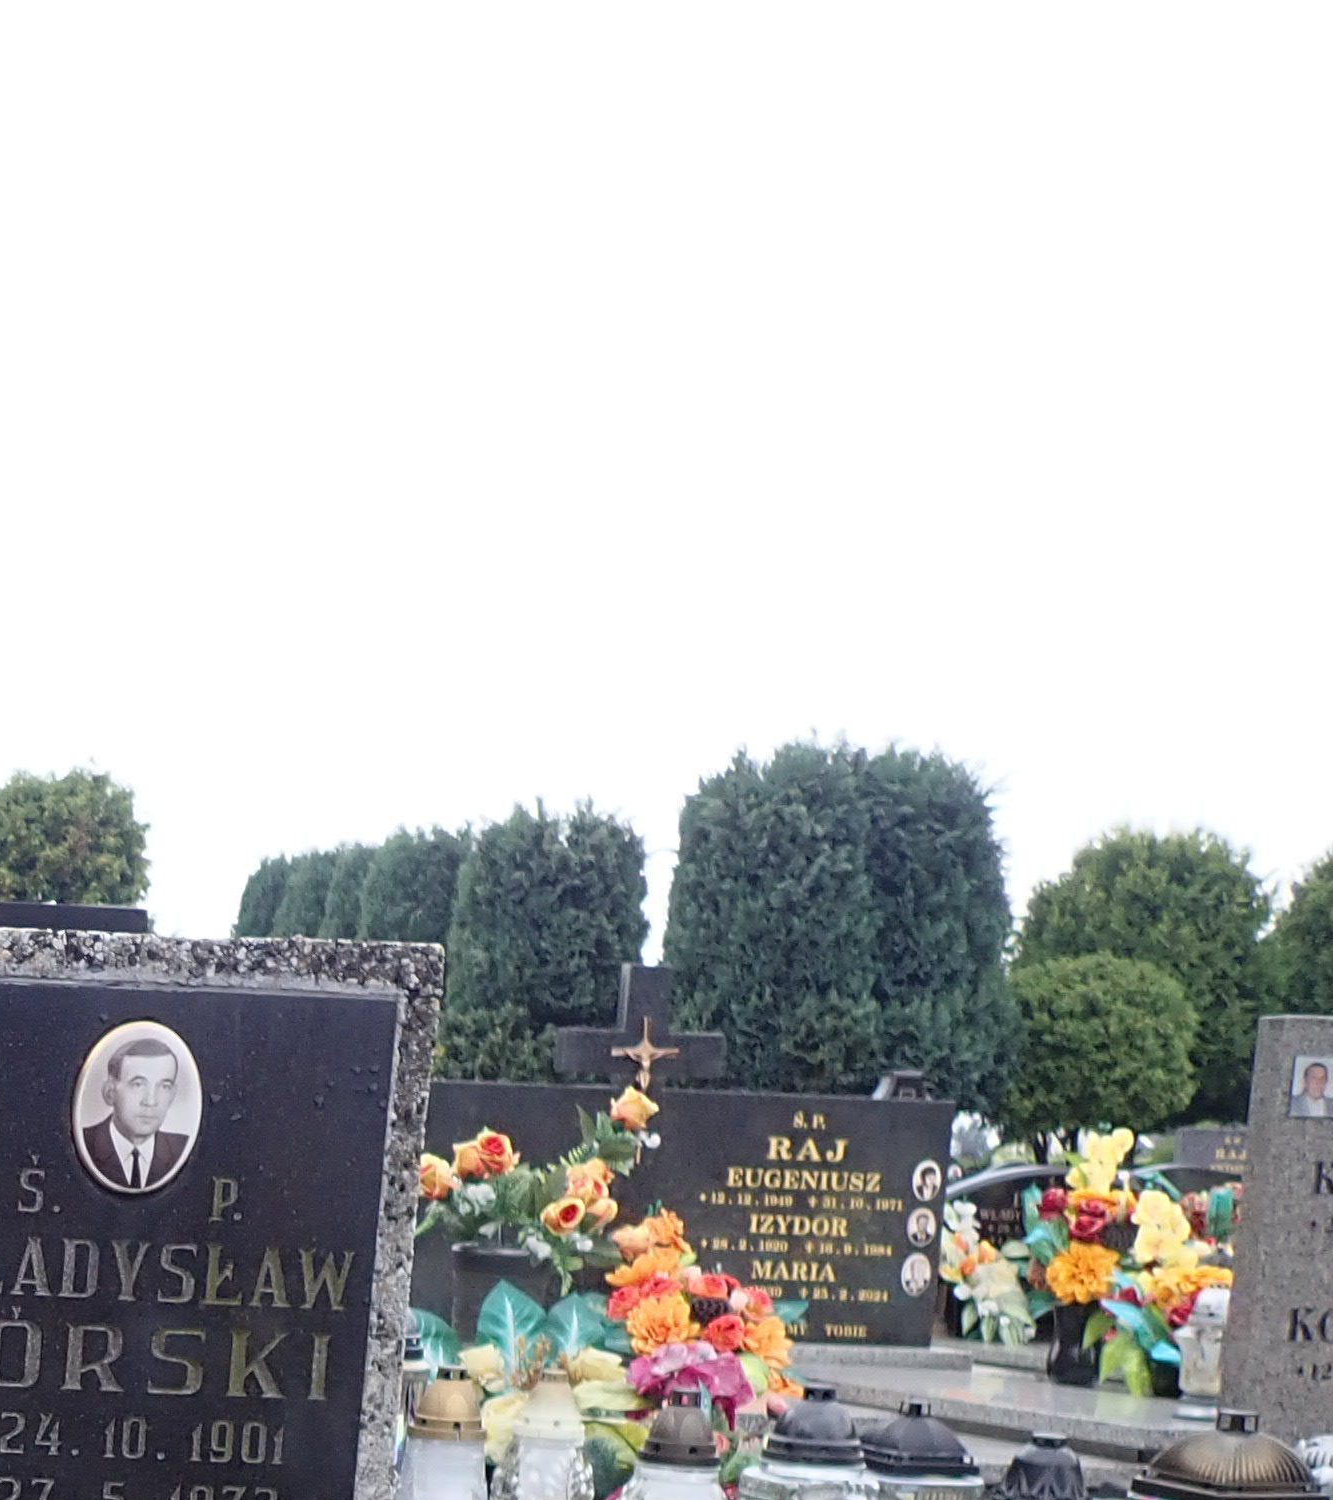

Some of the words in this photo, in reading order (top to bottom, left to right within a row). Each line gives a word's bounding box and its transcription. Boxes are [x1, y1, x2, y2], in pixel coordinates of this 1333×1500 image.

[767, 1135, 850, 1163] RAJ
[18, 1154, 61, 1213] Ś.
[209, 1176, 241, 1221] P.
[725, 1166, 882, 1193] EUGENIUSZ
[749, 1213, 849, 1238] IZYDOR
[751, 1259, 836, 1283] MARIA
